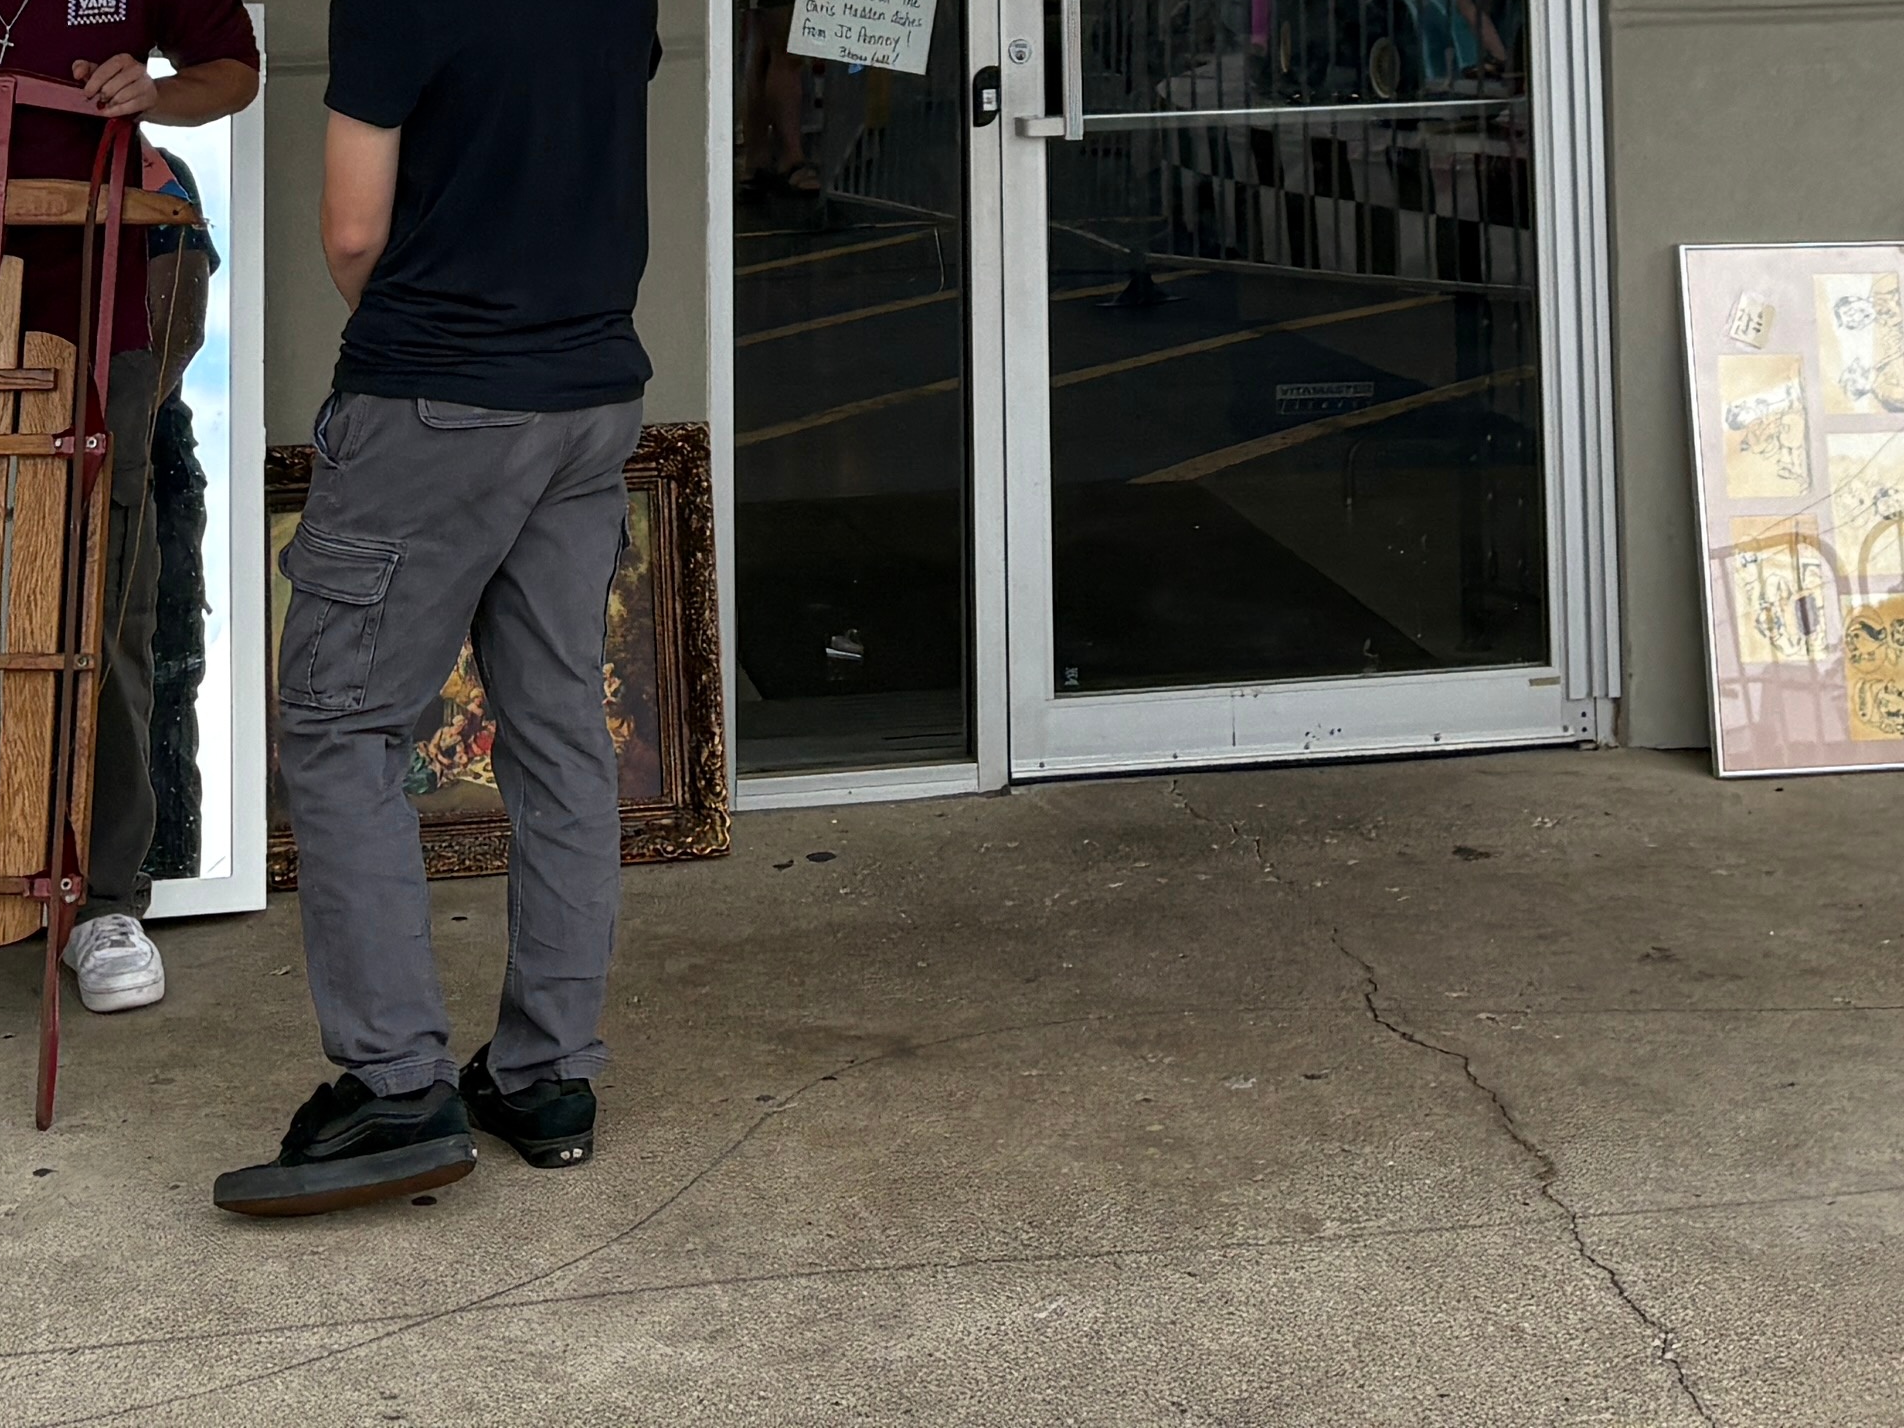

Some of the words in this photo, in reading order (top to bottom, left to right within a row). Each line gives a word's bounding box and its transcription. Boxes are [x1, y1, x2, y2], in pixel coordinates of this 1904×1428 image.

[806, 0, 836, 16] Chris
[843, 3, 886, 21] Madden
[802, 17, 826, 39] from
[834, 24, 852, 39] JC
